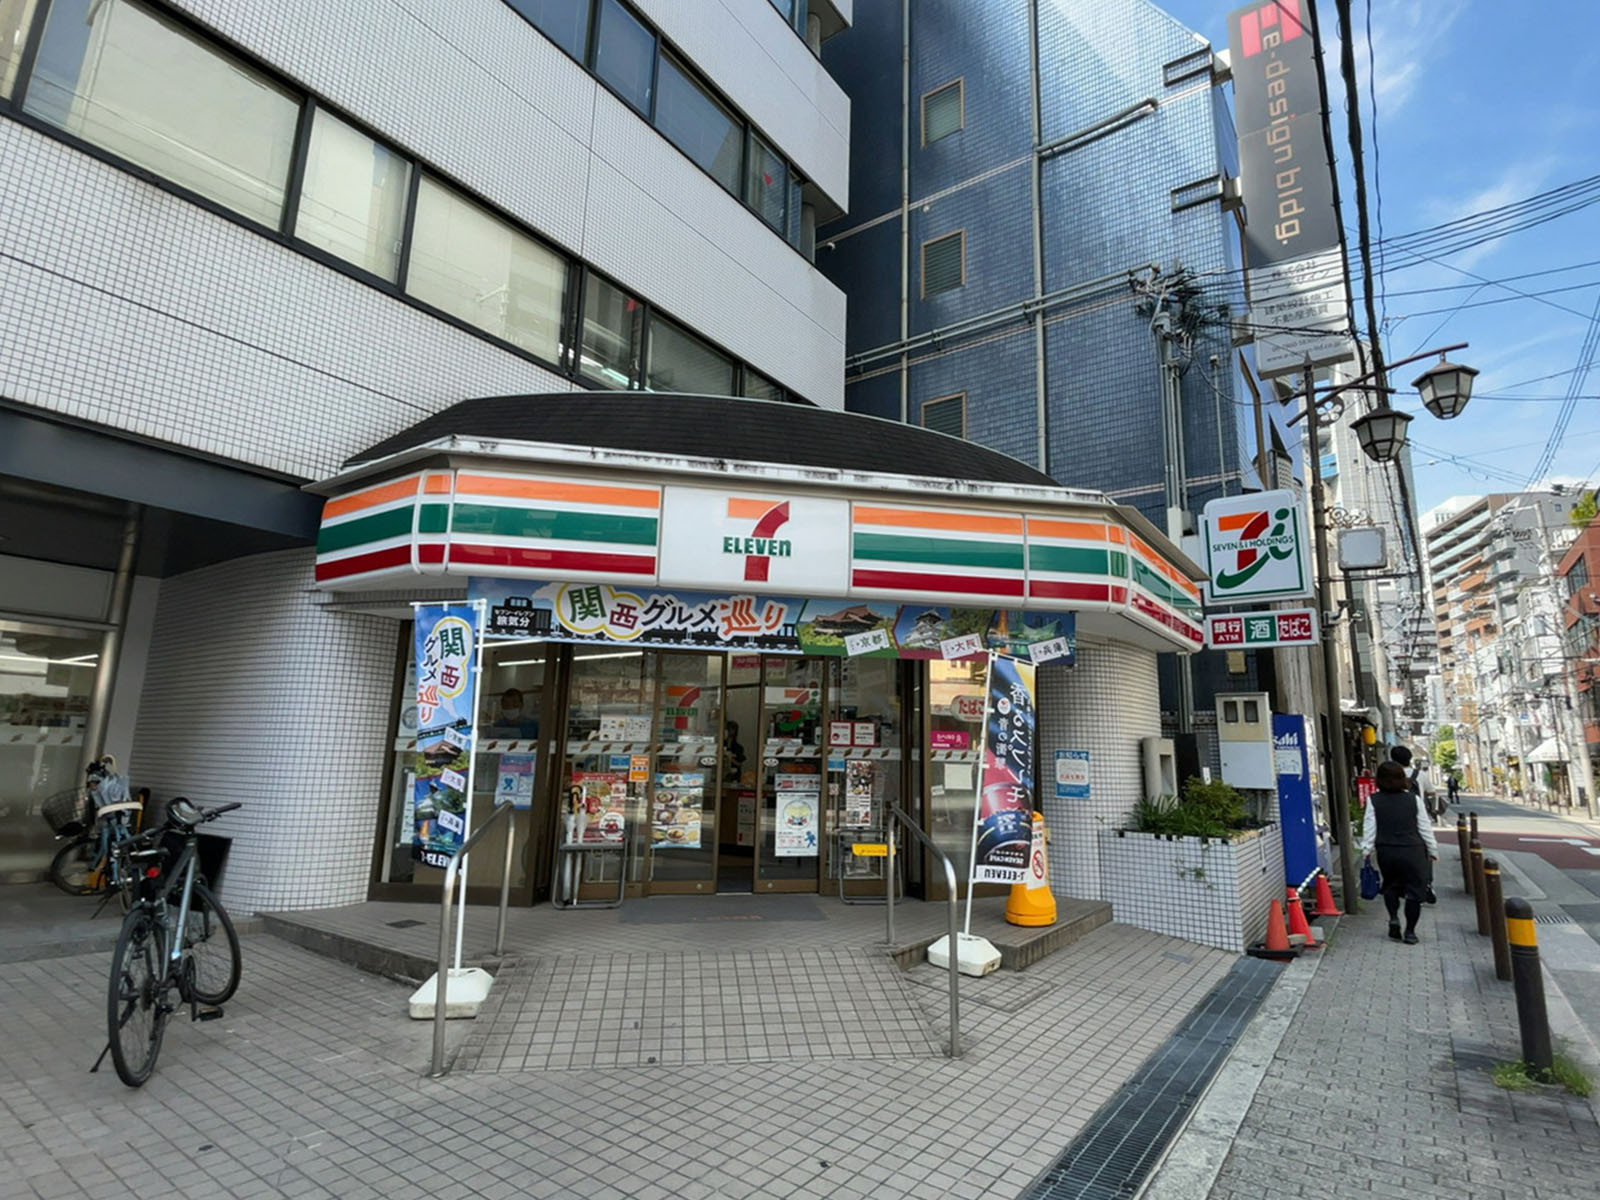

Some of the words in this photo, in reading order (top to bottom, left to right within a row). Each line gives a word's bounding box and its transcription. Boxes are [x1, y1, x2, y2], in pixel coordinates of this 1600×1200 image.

[1262, 30, 1298, 164] e-design
[1275, 166, 1306, 246] bldg.
[727, 497, 790, 582] 7
[1249, 535, 1294, 547] HOLDINGS
[568, 585, 785, 636] 関西グルメ巡り
[1213, 620, 1241, 634] 銀行
[1250, 619, 1271, 639] 酒
[1279, 617, 1312, 638] たばこ
[860, 631, 883, 649] 京都
[954, 638, 977, 651] 大阪
[438, 626, 466, 690] 関西
[416, 635, 440, 724] グルメ巡り
[1272, 732, 1298, 745] sahi
